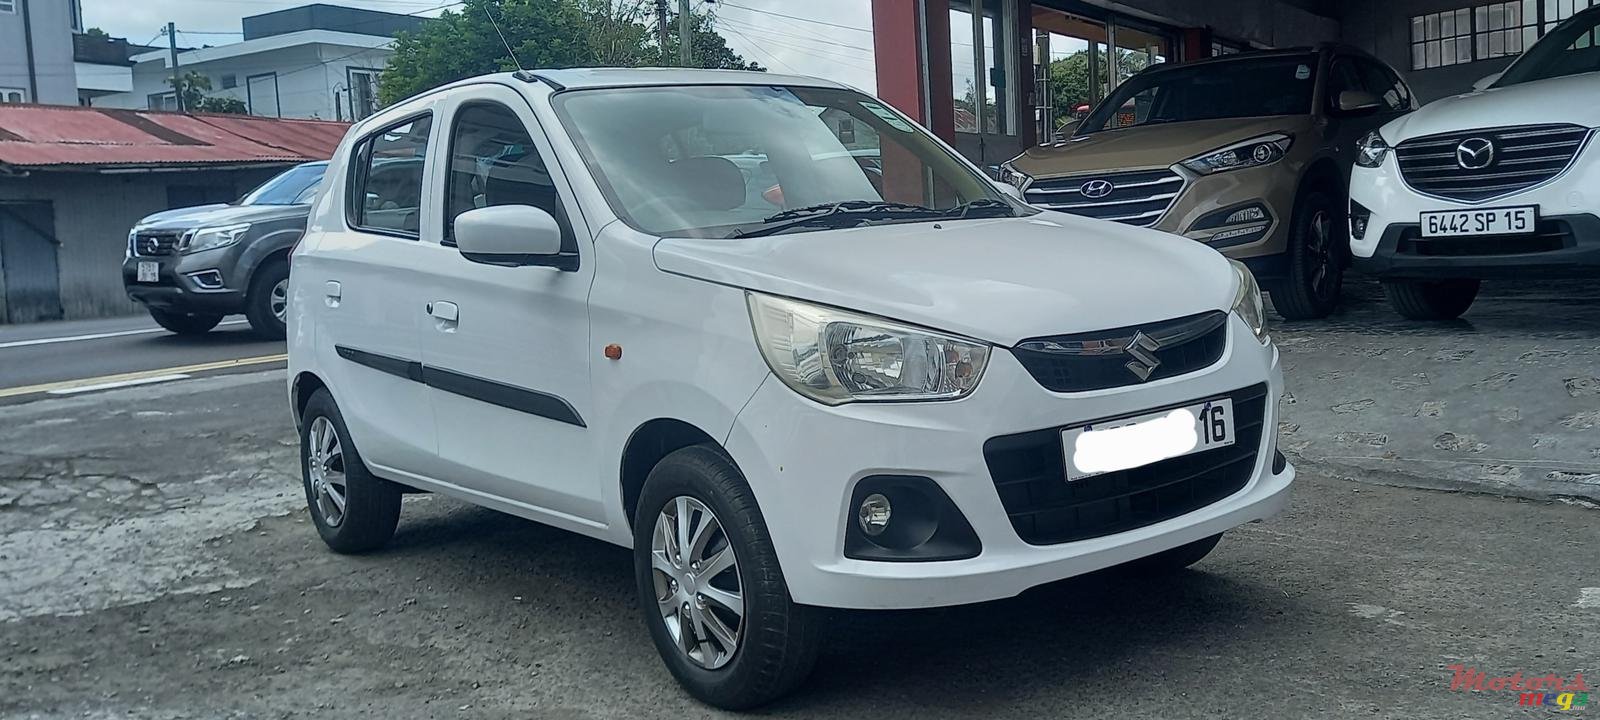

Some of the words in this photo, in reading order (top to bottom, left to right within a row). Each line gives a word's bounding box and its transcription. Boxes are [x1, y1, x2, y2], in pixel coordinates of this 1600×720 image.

[1429, 214, 1469, 234] 6442
[1475, 212, 1496, 232] SP
[1504, 211, 1525, 230] 15
[1199, 406, 1226, 444] 16
